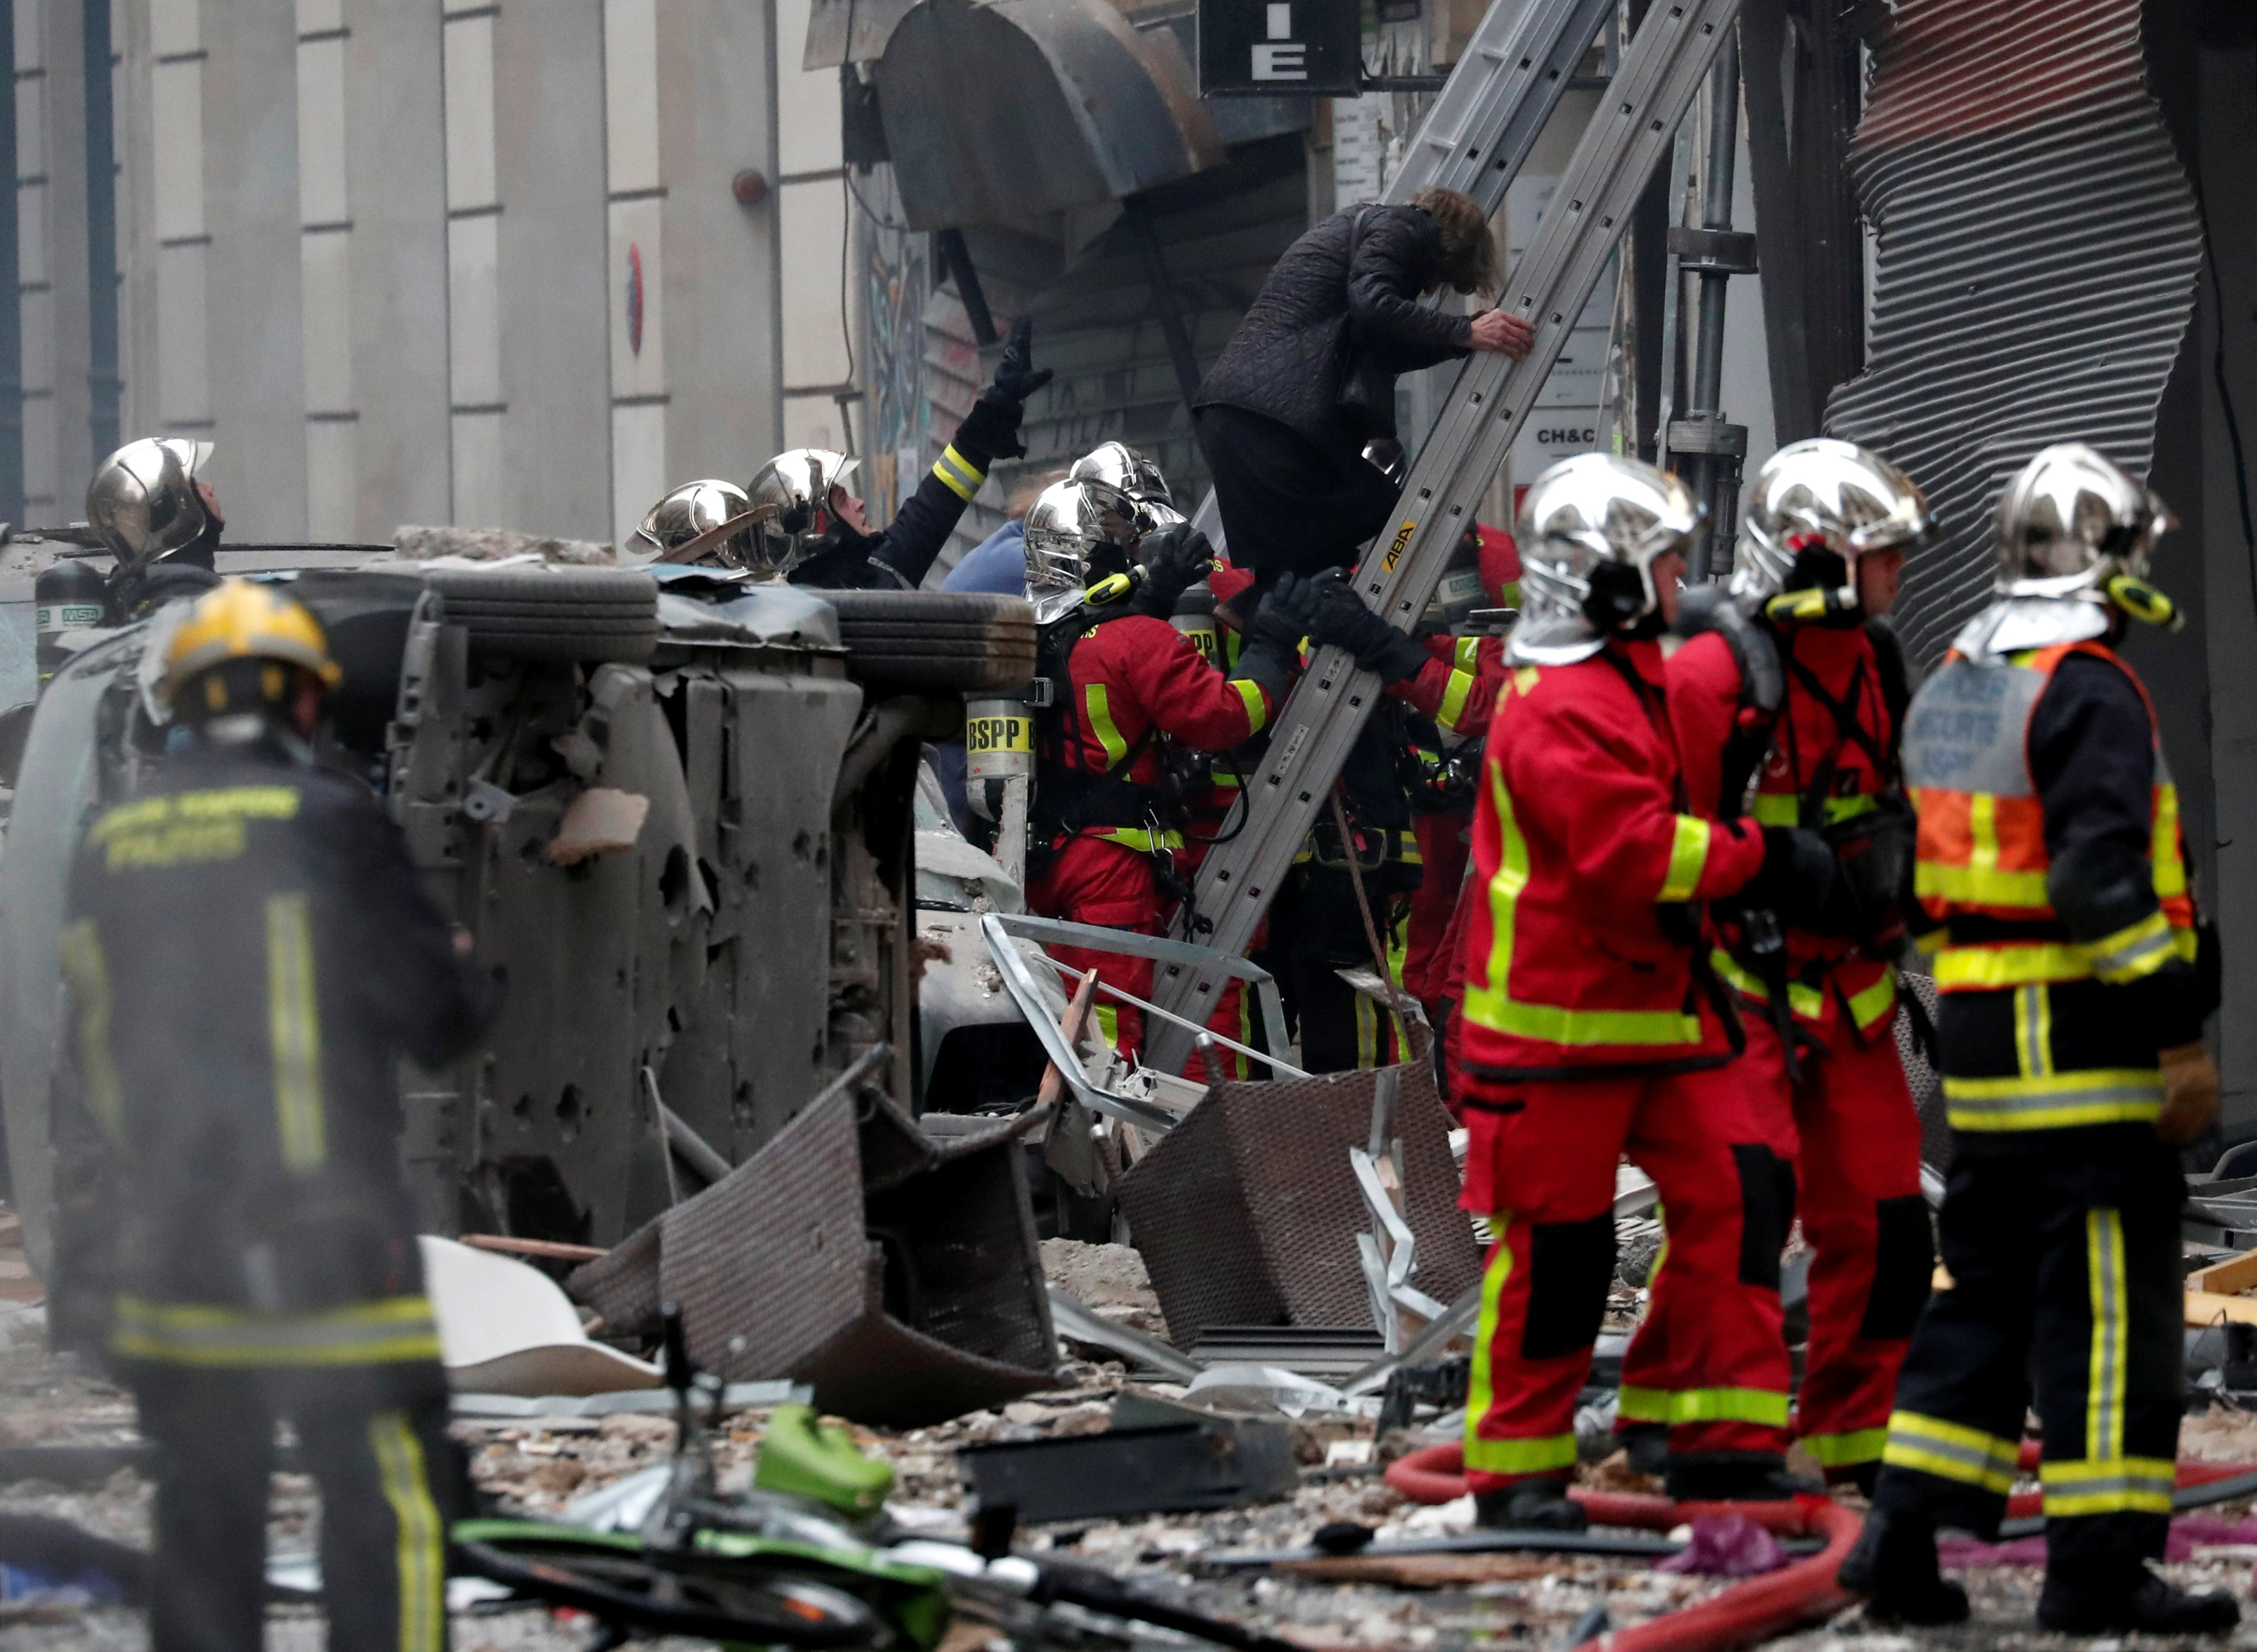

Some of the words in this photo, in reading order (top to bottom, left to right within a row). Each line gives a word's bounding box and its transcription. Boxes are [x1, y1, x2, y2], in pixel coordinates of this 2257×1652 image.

[1537, 429, 1595, 444] CH&C
[1386, 527, 1415, 571] ABA
[64, 608, 97, 621] MSA
[969, 719, 1020, 751] BSPP
